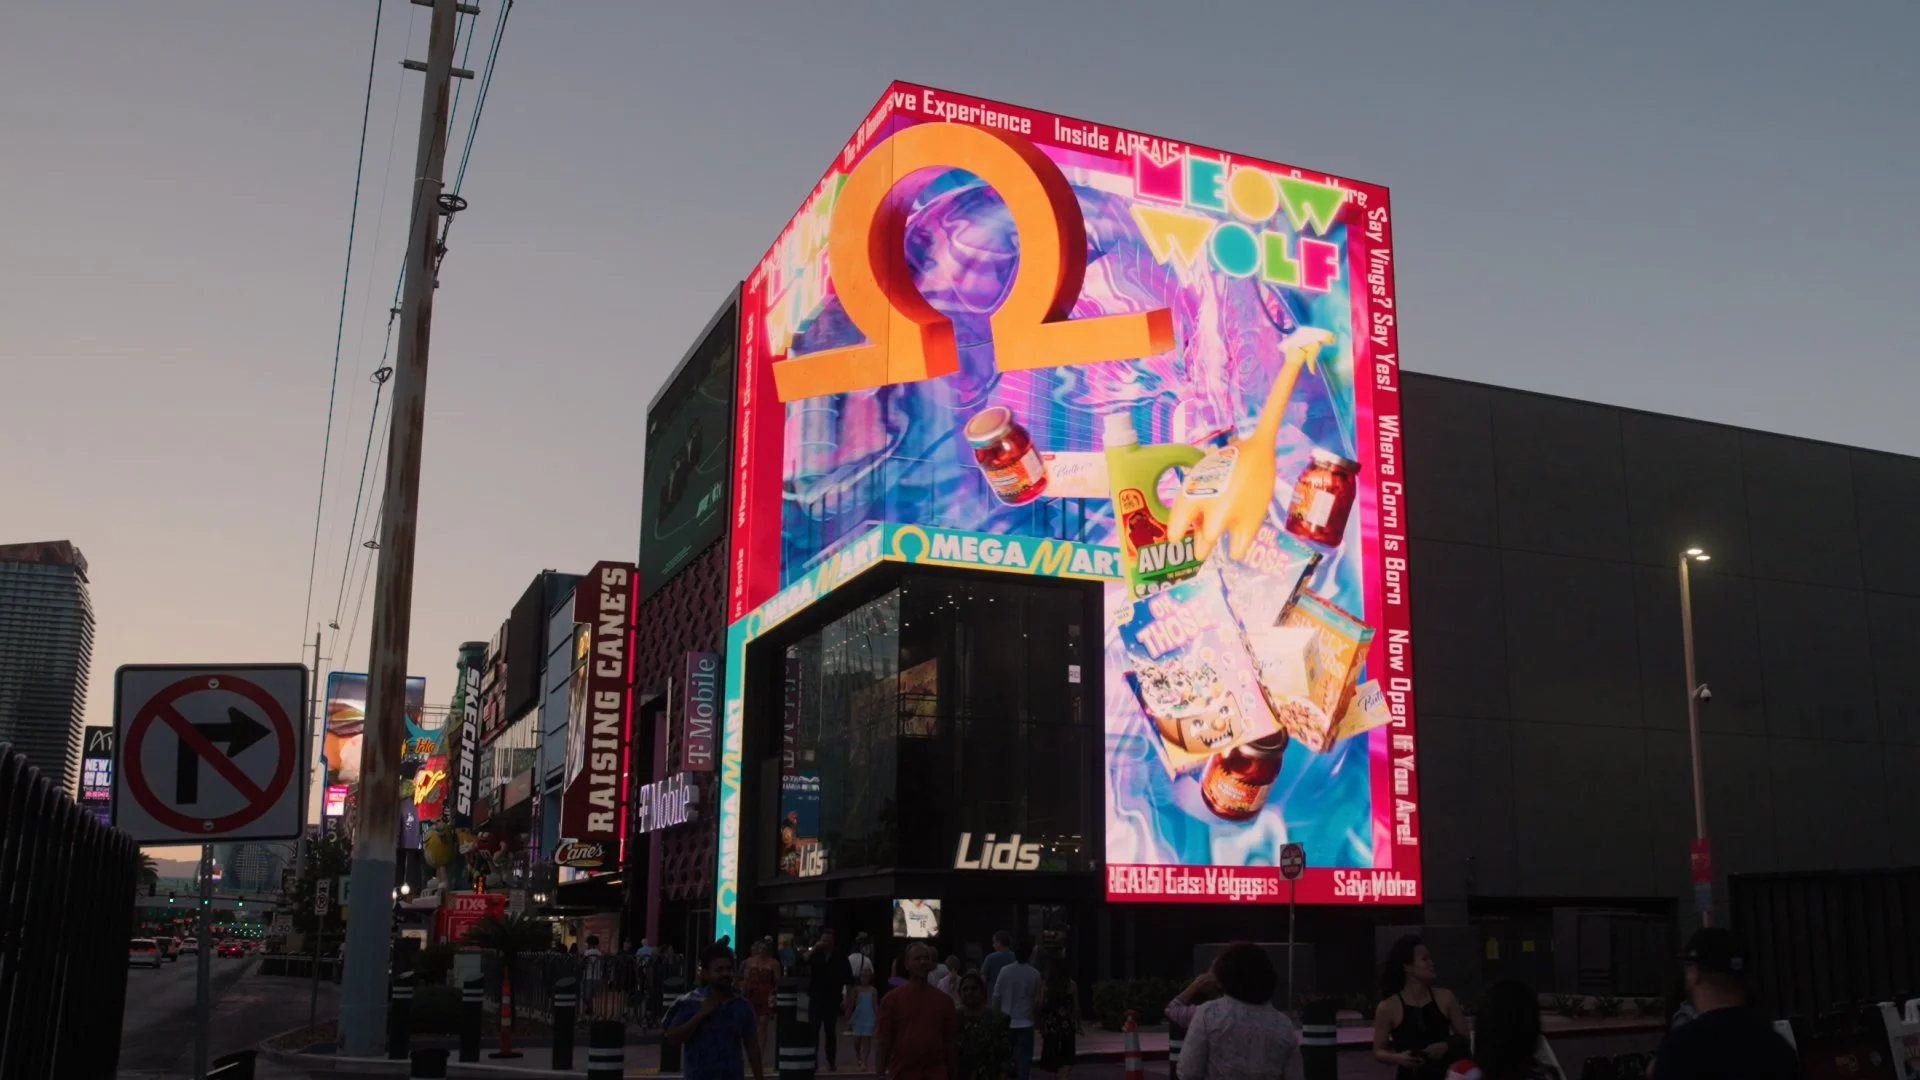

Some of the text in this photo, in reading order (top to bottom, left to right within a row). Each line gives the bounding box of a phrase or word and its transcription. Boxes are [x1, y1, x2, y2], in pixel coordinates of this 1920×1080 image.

[923, 90, 1031, 134] Experience
[1055, 118, 1109, 151] Inside
[1133, 149, 1347, 237] MEOW
[1366, 207, 1387, 243] Say
[1129, 204, 1340, 293] WOLF
[1368, 249, 1393, 308] Vings?
[1371, 312, 1393, 346] Say
[1376, 353, 1397, 392] Yes!
[1379, 415, 1399, 476] Where
[1381, 482, 1402, 528] Corn
[1384, 534, 1404, 551] Is
[1386, 558, 1405, 605] Born
[1389, 629, 1409, 671] Now
[588, 567, 628, 833] RAISING CANE'S
[1387, 677, 1411, 728] Open
[456, 666, 480, 817] SKECHERS
[1394, 754, 1414, 795] You
[555, 843, 605, 865] Cane's
[799, 843, 825, 877] Lids
[954, 832, 1041, 870] Lids
[1371, 871, 1416, 896] More
